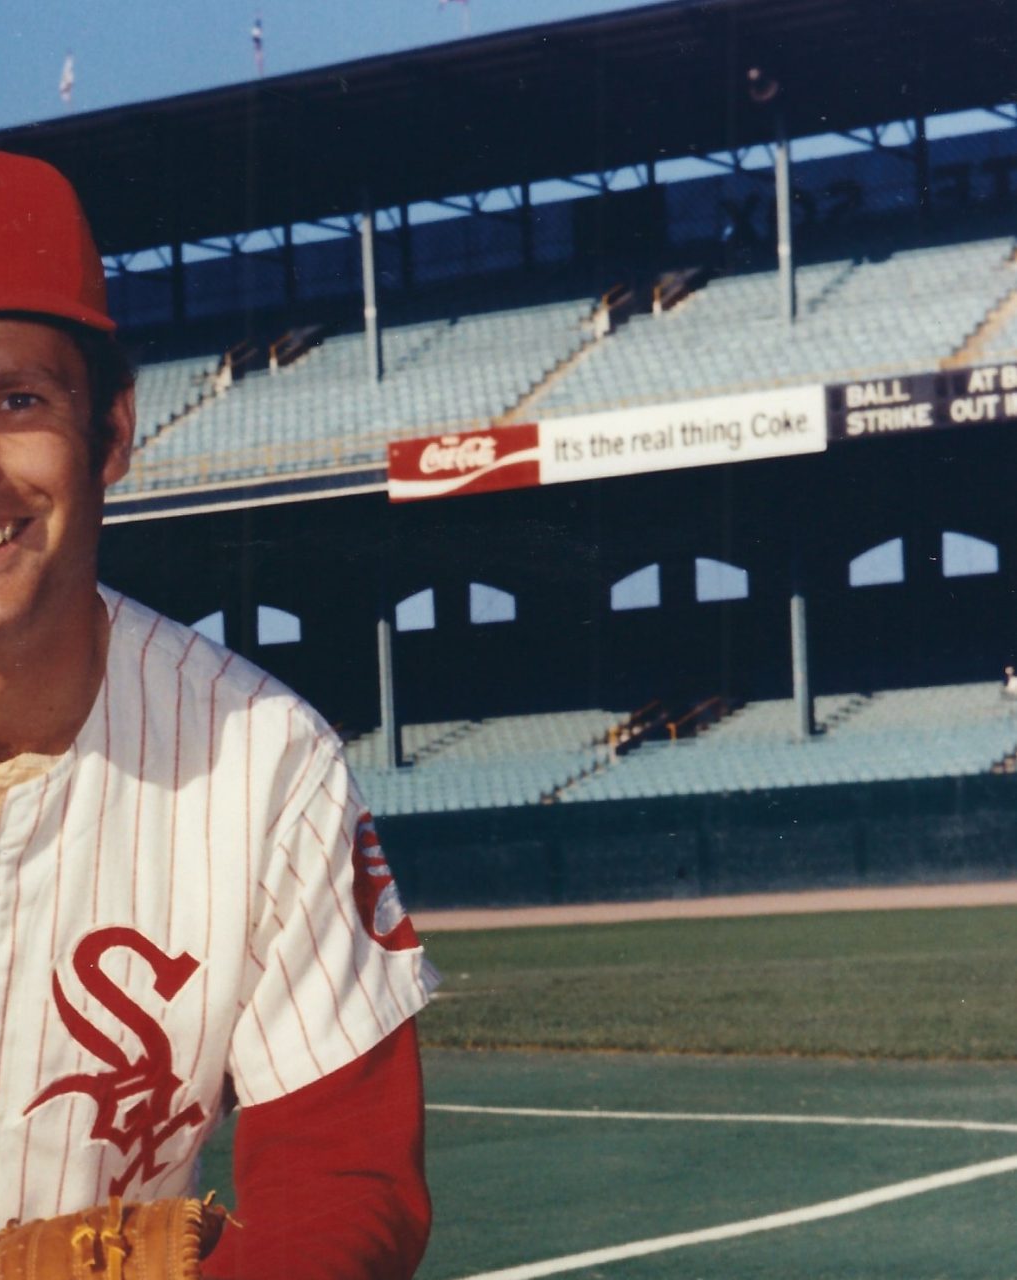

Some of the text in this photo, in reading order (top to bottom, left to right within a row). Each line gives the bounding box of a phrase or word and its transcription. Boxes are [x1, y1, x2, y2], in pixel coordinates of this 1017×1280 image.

[846, 379, 910, 408] BALL
[968, 367, 998, 393] AT
[846, 402, 933, 436] STRIKE
[950, 394, 1000, 422] OUT
[554, 437, 583, 461] It's
[590, 431, 624, 458] the
[631, 423, 673, 452] real
